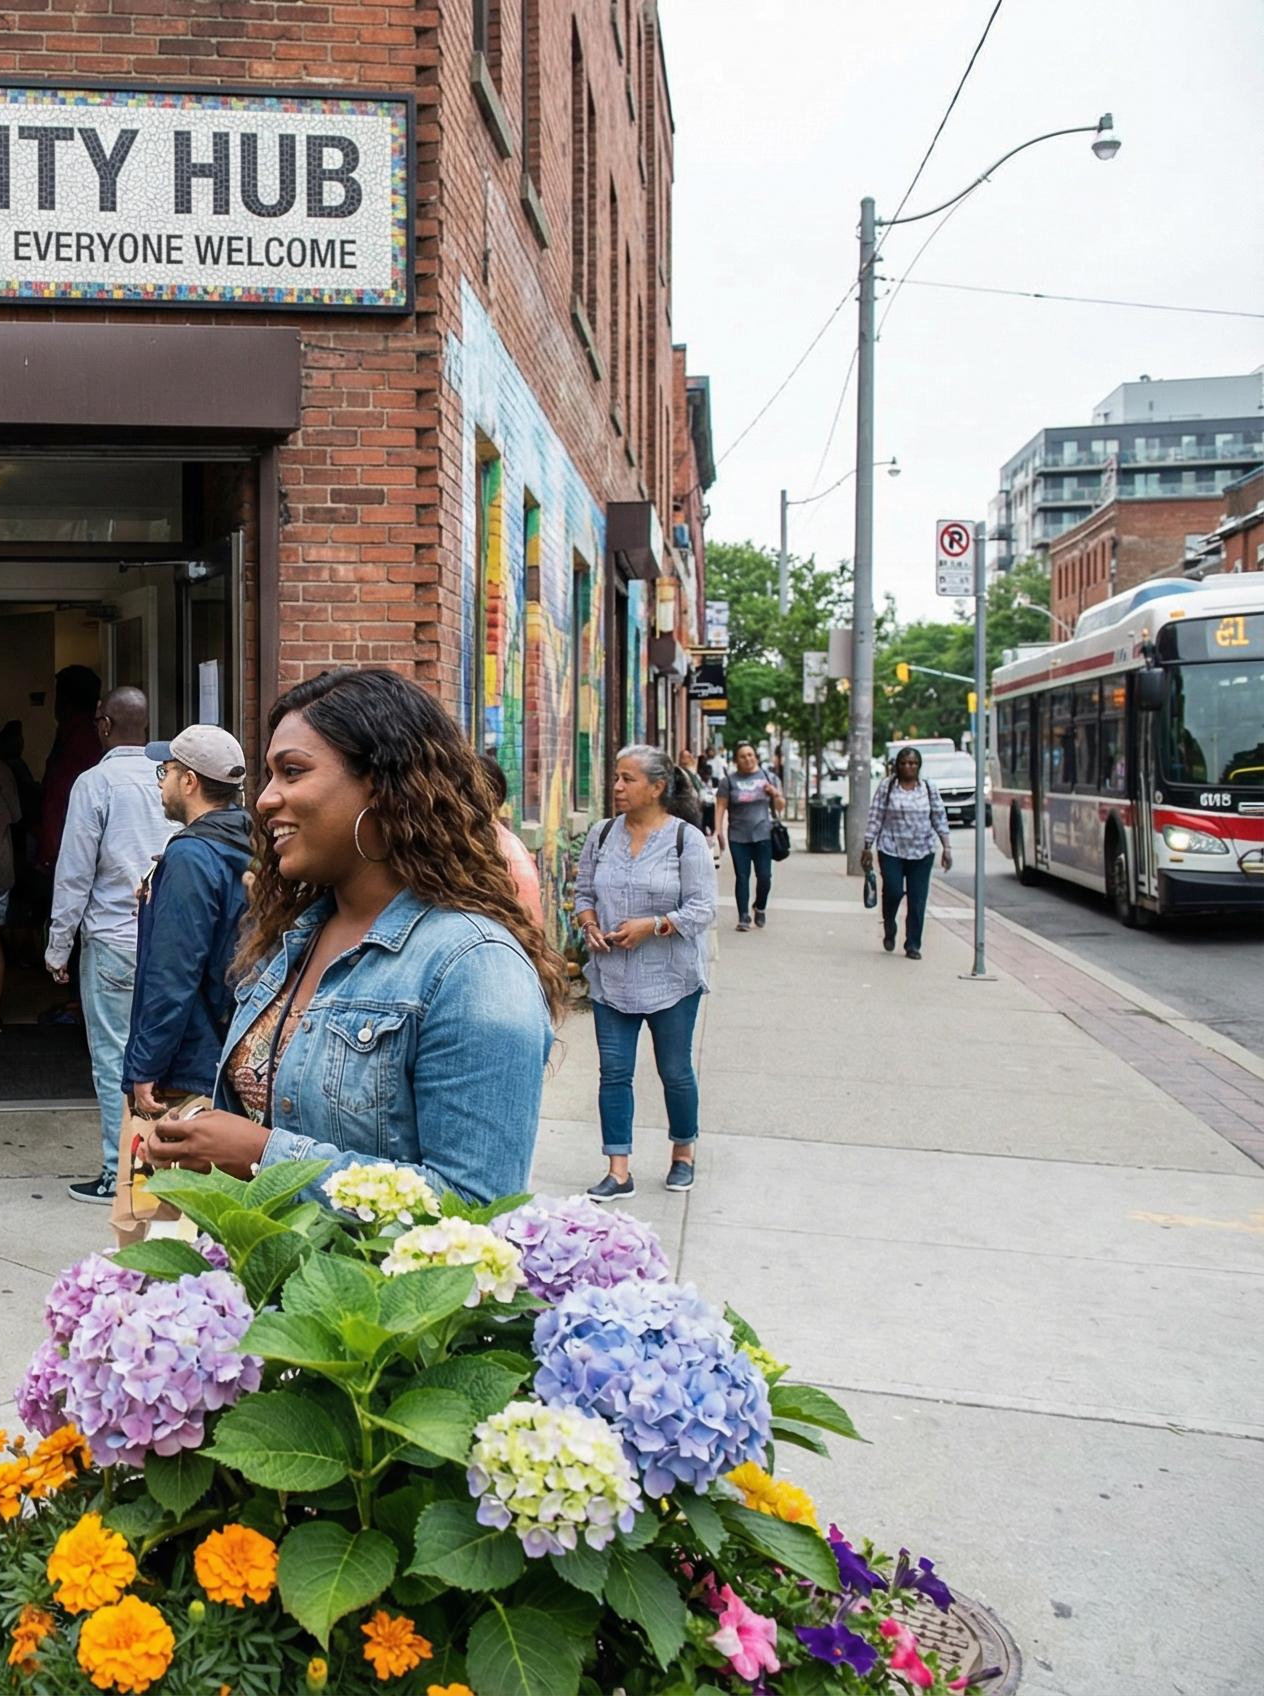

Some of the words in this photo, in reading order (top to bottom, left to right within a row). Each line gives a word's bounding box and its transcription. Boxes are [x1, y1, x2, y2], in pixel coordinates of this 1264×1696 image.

[174, 130, 363, 218] HUB
[12, 230, 184, 265] EVERYONE
[194, 235, 358, 270] WELCOME
